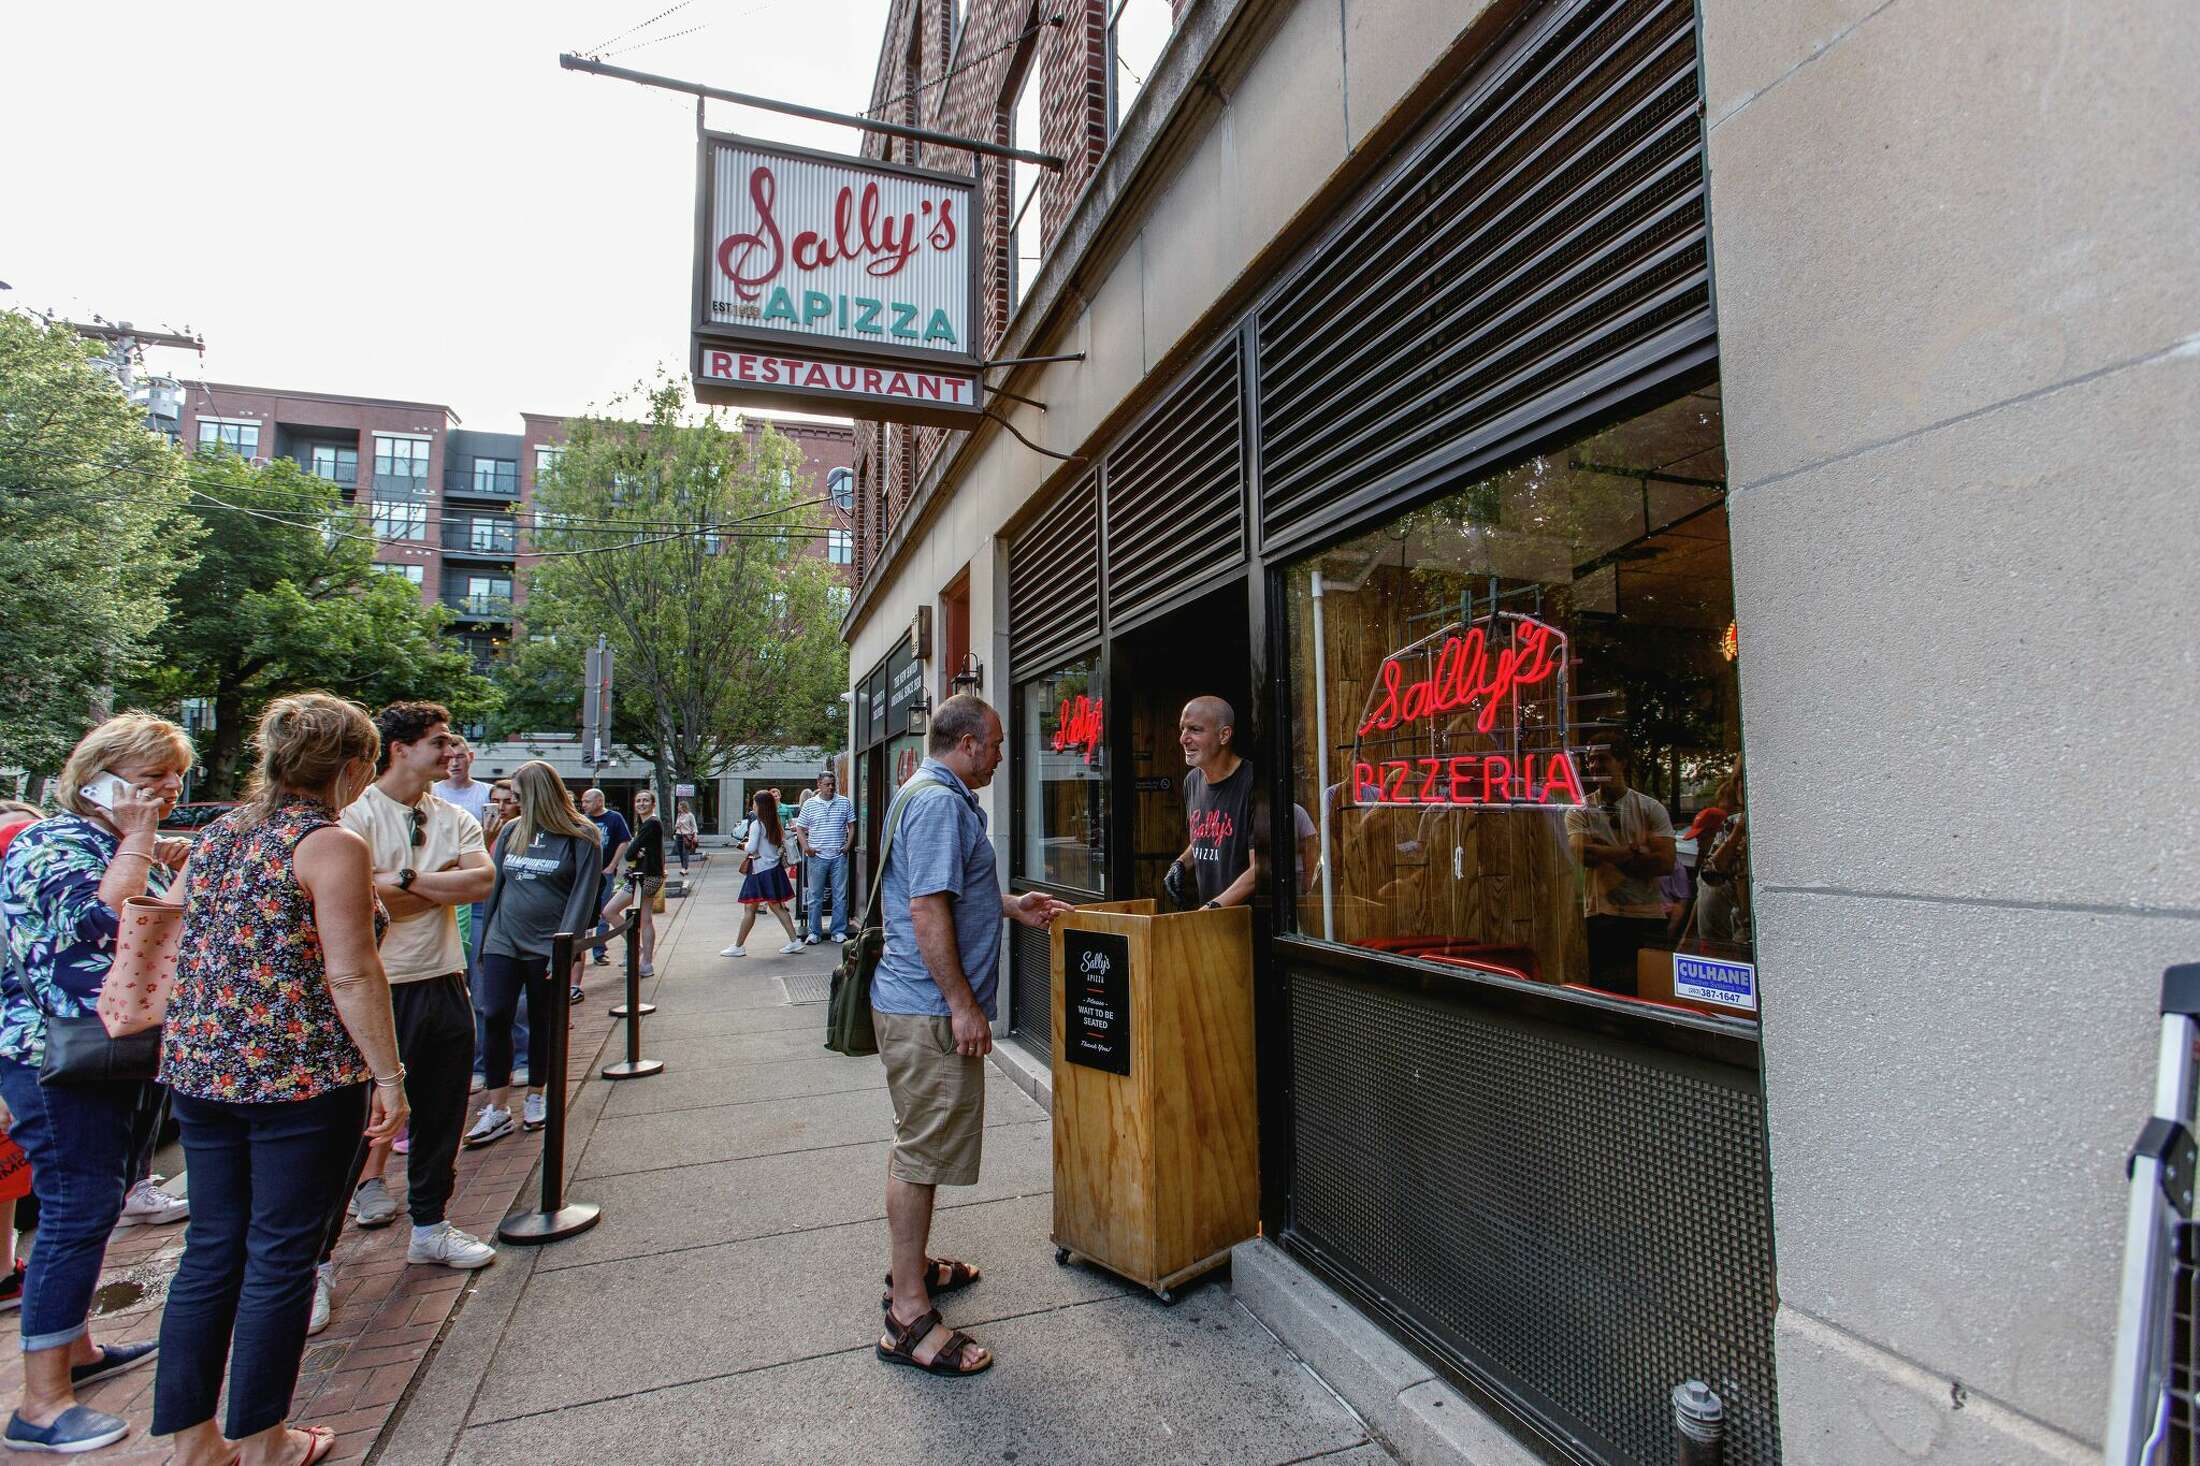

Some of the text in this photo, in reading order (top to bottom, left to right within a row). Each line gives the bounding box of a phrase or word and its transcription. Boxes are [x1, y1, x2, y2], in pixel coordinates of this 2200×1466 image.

[718, 166, 957, 301] Sally's
[762, 286, 958, 345] APIZZA
[711, 351, 967, 403] RESTAURANT
[1359, 620, 1554, 734] Sally's
[1354, 752, 1583, 805] PIZZERIA
[1190, 809, 1233, 848] Sally's
[1080, 950, 1111, 975] Sally's
[1679, 962, 1750, 986] CULHANE
[1700, 988, 1741, 1003] 387-1647
[1078, 1005, 1114, 1020] WAIT TO BE
[1083, 1016, 1108, 1029] SEATED
[1080, 1040, 1098, 1050] Thank
